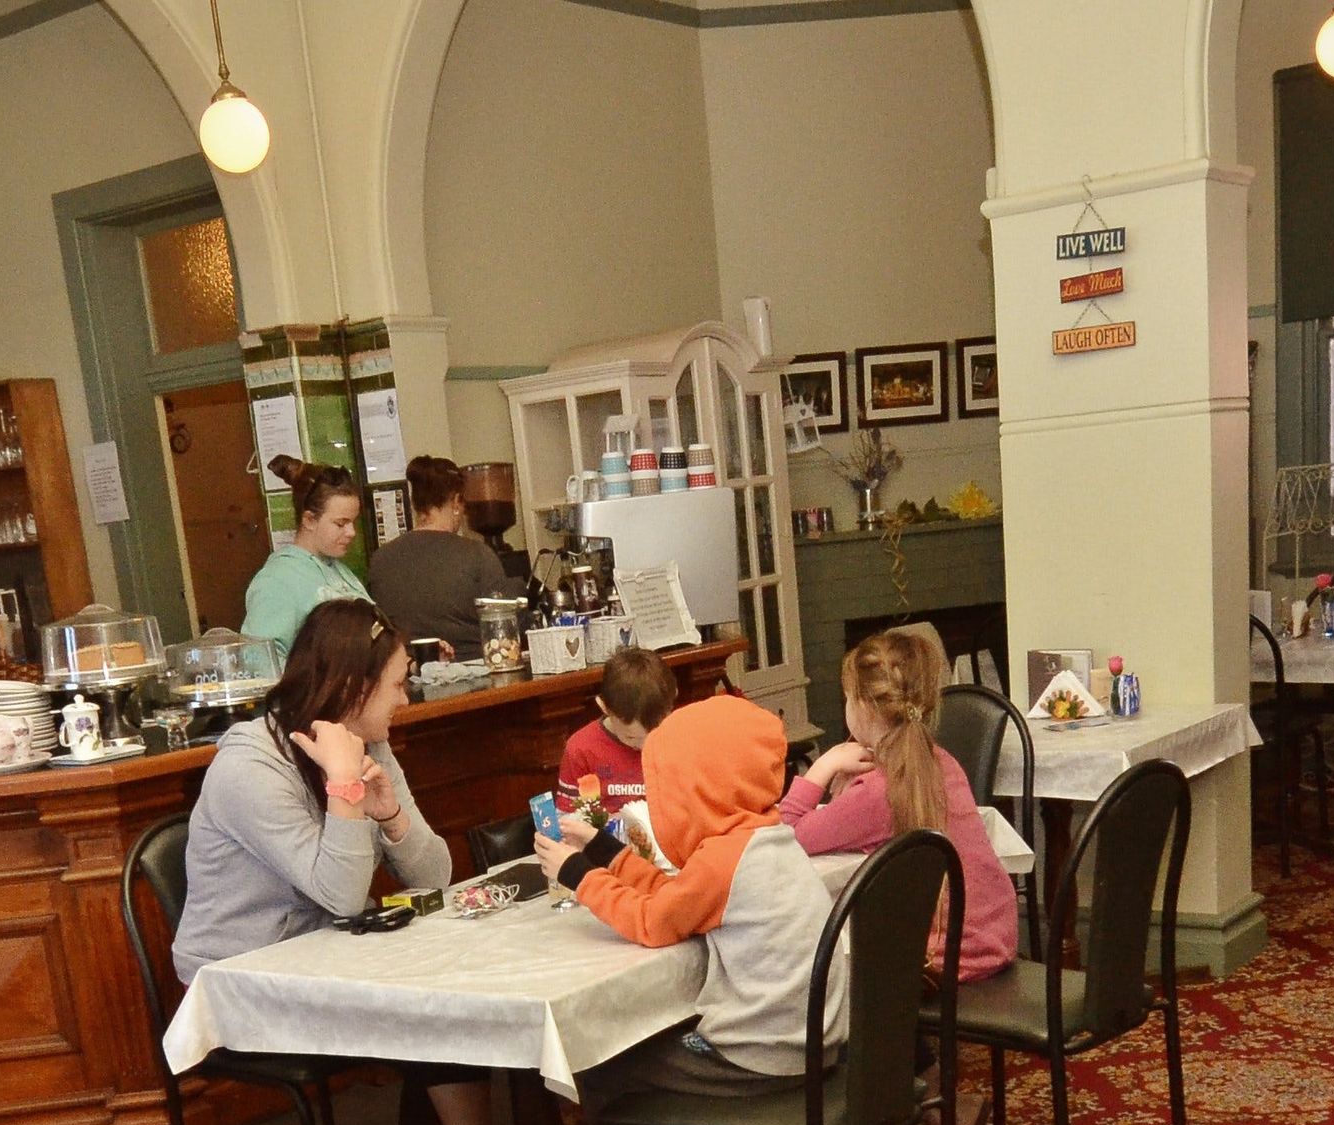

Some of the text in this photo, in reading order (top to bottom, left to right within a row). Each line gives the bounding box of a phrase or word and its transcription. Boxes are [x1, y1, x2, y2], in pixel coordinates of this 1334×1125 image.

[1059, 231, 1124, 257] LIVE WELL
[1063, 270, 1123, 297] Love Much
[1055, 325, 1132, 351] LAUGH OFTEN
